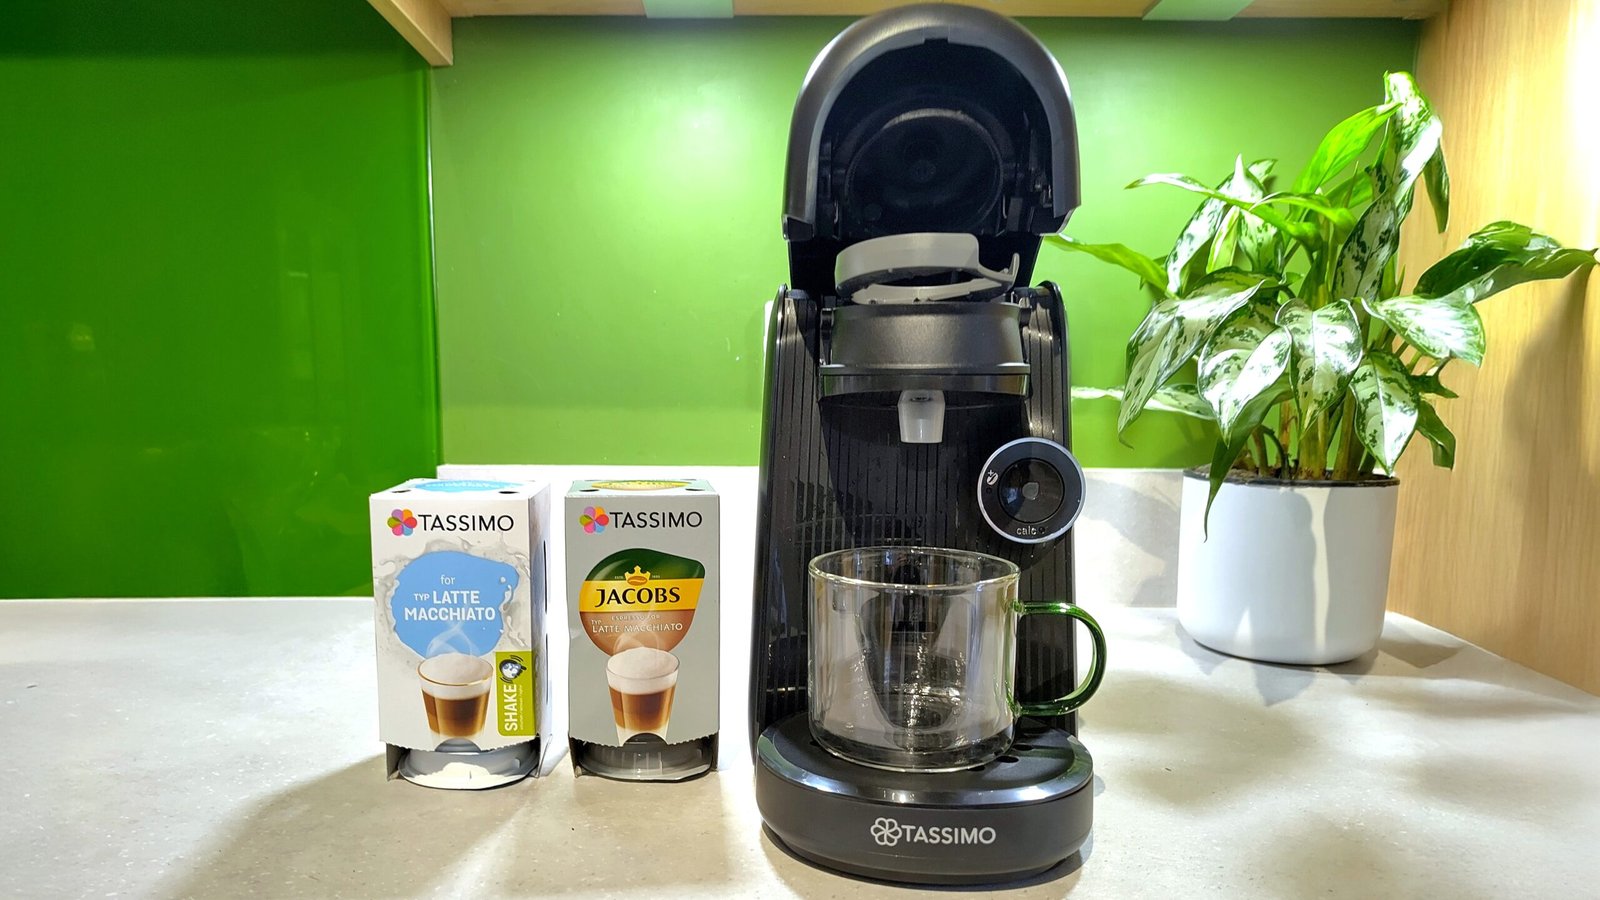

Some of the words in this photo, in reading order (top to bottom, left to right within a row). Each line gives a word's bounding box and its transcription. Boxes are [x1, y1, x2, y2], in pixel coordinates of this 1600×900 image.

[418, 514, 514, 532] TASSIMO
[609, 511, 703, 528] TASSIMO
[1016, 525, 1037, 536] calc
[440, 575, 456, 585] for
[414, 593, 430, 601] TYP
[432, 590, 480, 604] LATTE
[594, 587, 681, 608] JACOBS
[404, 607, 496, 621] MACCHIATO
[592, 625, 620, 633] LATTE
[624, 622, 683, 632] MACCHIATO
[503, 684, 518, 731] SHAKE
[901, 825, 996, 844] TASSIMO
